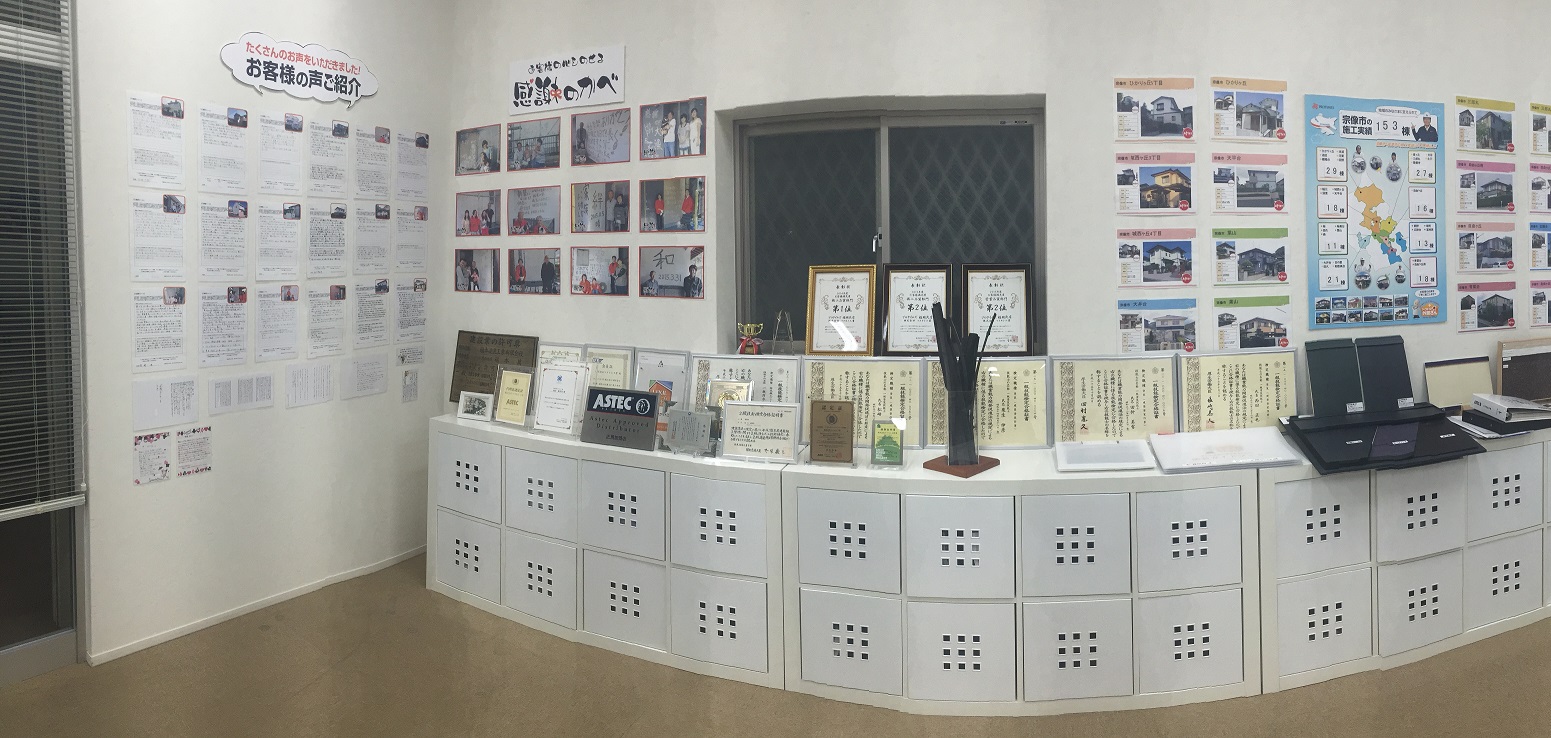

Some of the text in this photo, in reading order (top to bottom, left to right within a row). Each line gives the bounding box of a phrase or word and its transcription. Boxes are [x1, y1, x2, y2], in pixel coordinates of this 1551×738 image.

[245, 41, 361, 75] たくさんのお声をいただきました!
[246, 57, 362, 97] お客様の声ご紹介
[1342, 115, 1373, 125] 宗像市の
[1342, 125, 1373, 136] 施工実績
[652, 249, 675, 269] 和
[832, 304, 853, 314] 第1位
[907, 303, 929, 312] 第2位
[986, 303, 1007, 312] 第2位
[592, 393, 632, 411] ASTEC
[589, 415, 650, 428] Astec Approved
[596, 423, 641, 433] Distributor
